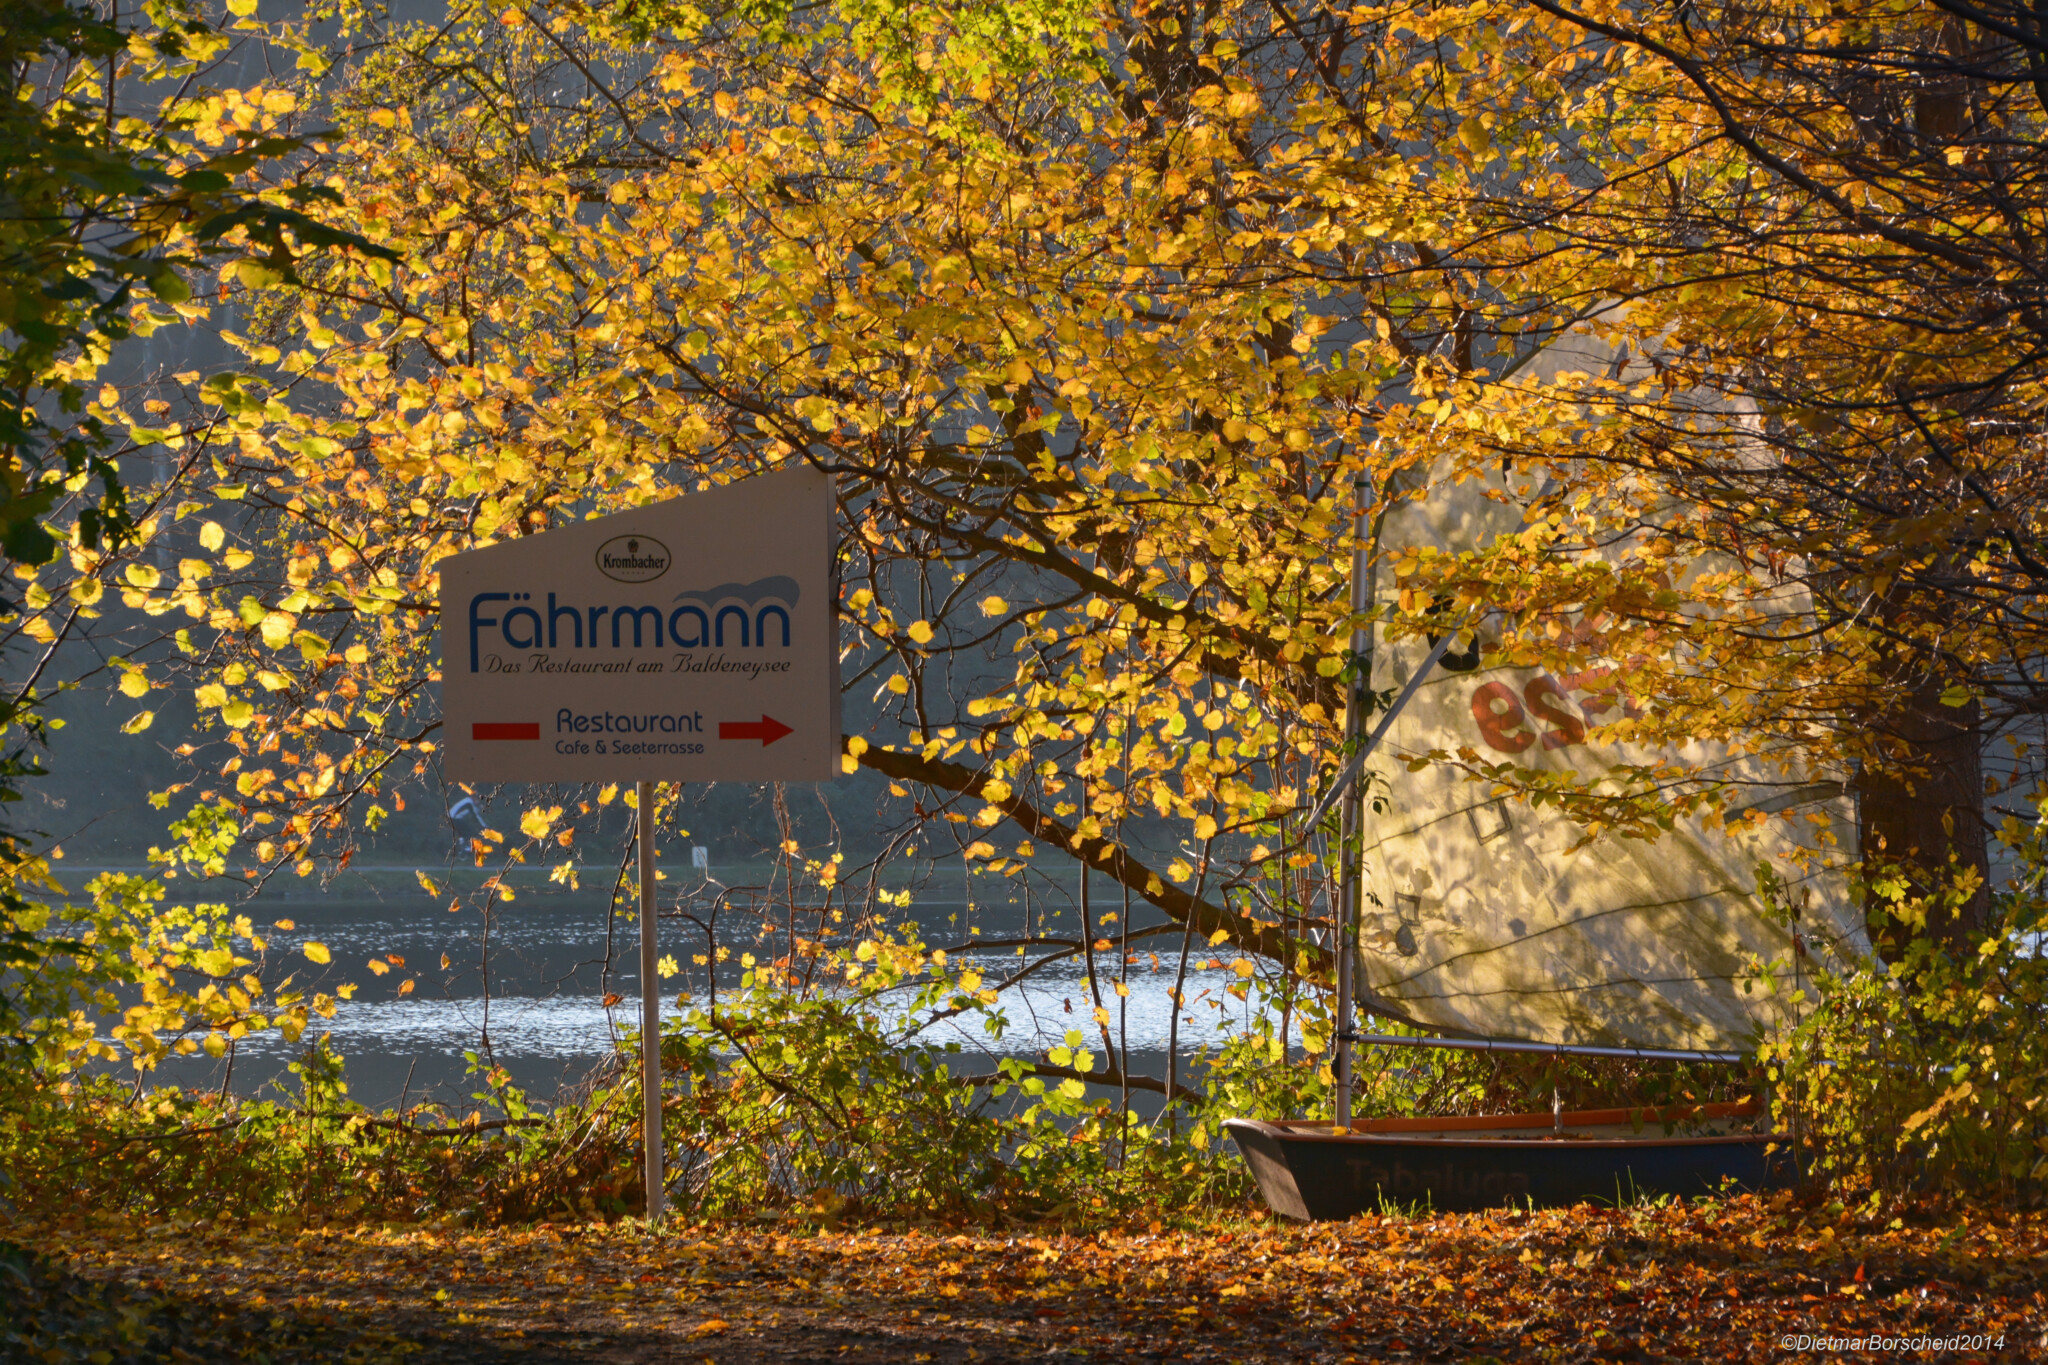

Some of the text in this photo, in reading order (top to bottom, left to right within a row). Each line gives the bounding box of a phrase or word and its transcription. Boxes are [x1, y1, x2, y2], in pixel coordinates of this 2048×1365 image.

[603, 552, 666, 569] Krombacher
[468, 591, 791, 673] Fährmann
[483, 652, 791, 681] Das Restaurant am Baldeneysee
[556, 707, 704, 733] Restaurant
[555, 739, 705, 755] Cafe & Seeterrasse
